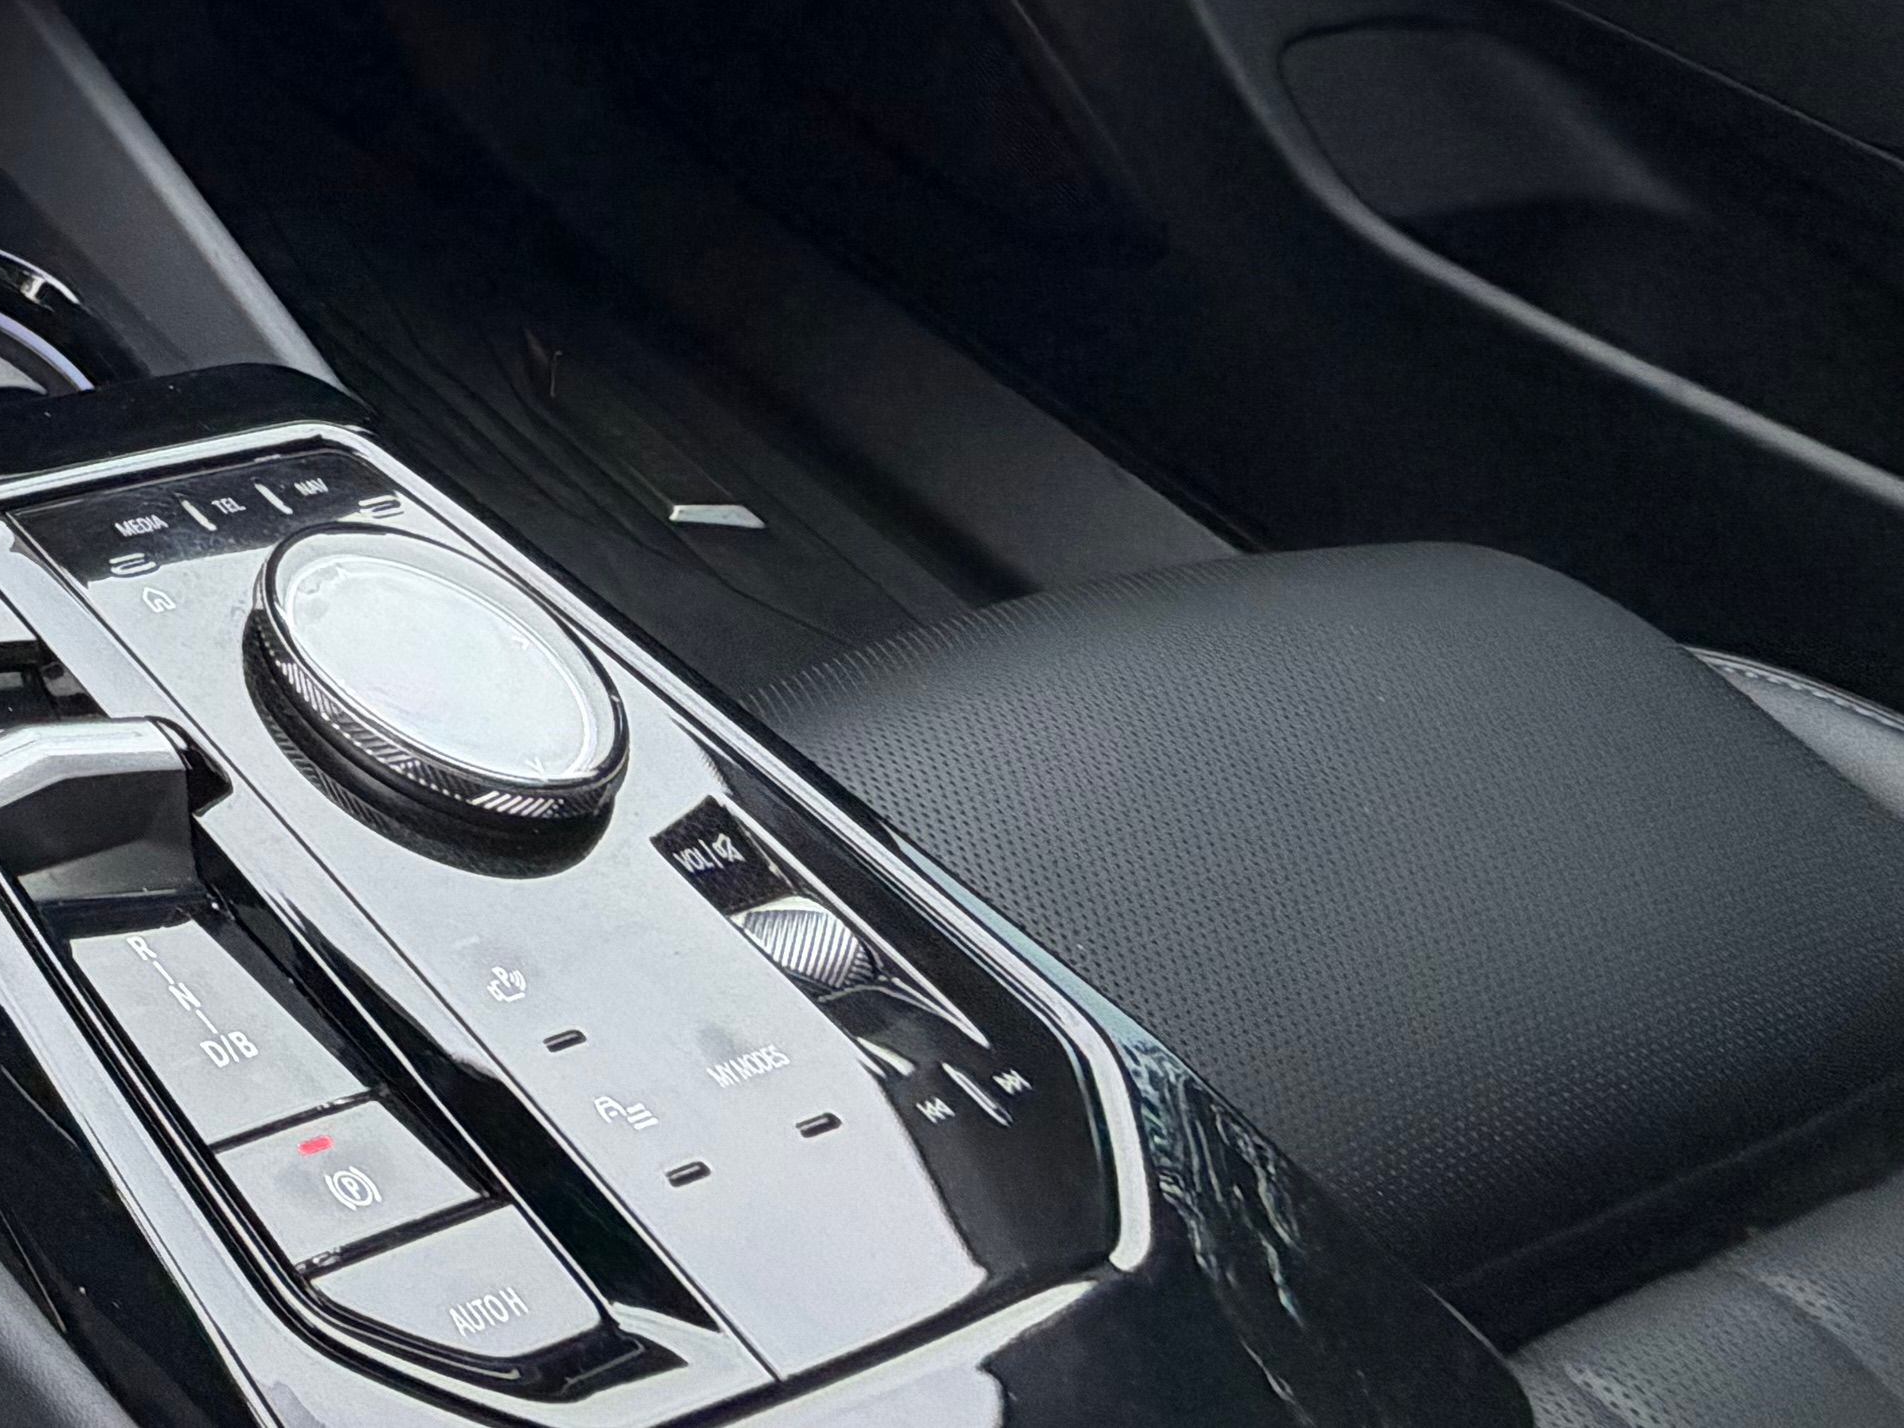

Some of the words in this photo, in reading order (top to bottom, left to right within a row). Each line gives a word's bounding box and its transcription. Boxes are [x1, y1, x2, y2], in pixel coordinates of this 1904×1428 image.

[293, 477, 329, 497] NAV
[210, 497, 247, 515] TEL
[114, 514, 169, 538] MEDIA
[673, 846, 714, 876] VOL
[126, 936, 157, 960] R
[168, 983, 201, 1011] N
[200, 1031, 259, 1069] D/B
[706, 1061, 741, 1089] MY
[729, 1044, 791, 1080] MODES
[448, 1294, 509, 1337] AUTO
[499, 1287, 529, 1317] H
